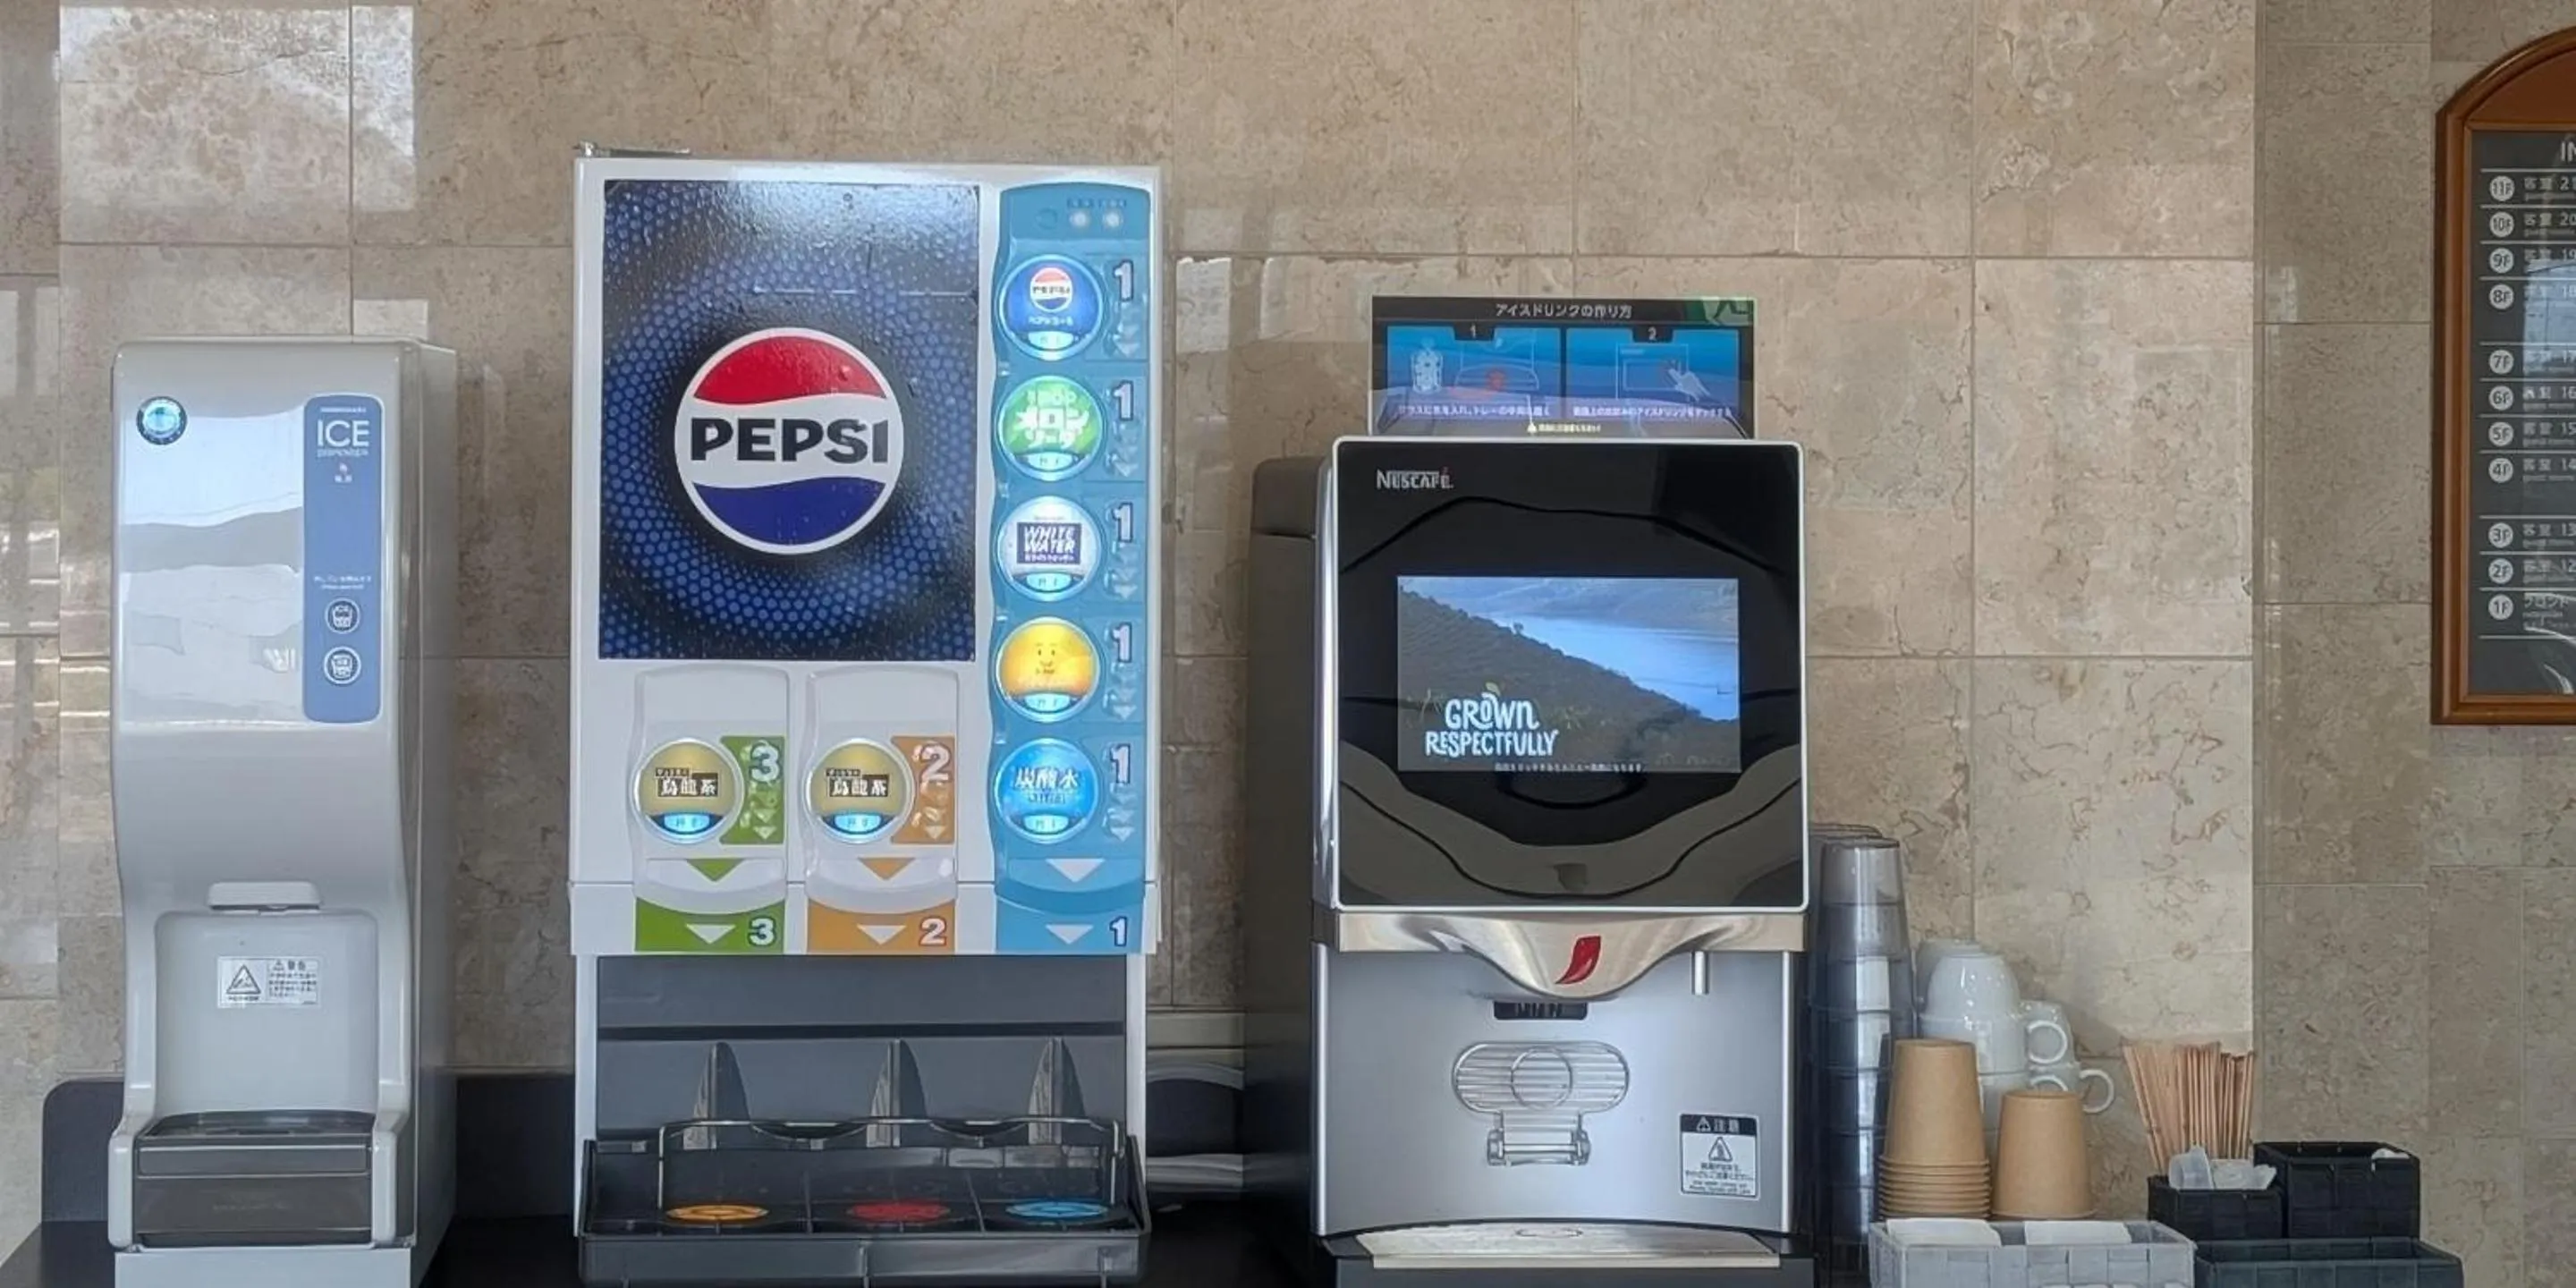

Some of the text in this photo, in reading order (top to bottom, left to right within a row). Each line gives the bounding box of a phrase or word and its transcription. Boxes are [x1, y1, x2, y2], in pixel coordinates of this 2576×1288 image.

[2493, 182, 2512, 196] 11F
[2493, 217, 2512, 233] 10F
[2493, 254, 2512, 267] 9F
[1114, 259, 1134, 302] 1
[1032, 285, 1071, 294] PEPSI
[2493, 290, 2511, 304] 8F
[1496, 302, 1633, 320] アイスドリンクの作り方
[1470, 325, 1478, 339] 1
[1648, 326, 1657, 341] 2
[2493, 355, 2511, 369] 7F
[1114, 379, 1134, 421] 1
[2493, 391, 2511, 404] 6F
[317, 419, 369, 447] ICE
[691, 418, 889, 464] PEPSI
[2492, 428, 2511, 441] 5F
[2492, 463, 2511, 477] 4F
[1113, 501, 1134, 543] 1
[1024, 525, 1076, 540] WHITE
[2492, 529, 2510, 542] 3F
[1024, 538, 1076, 554] WATER
[2492, 564, 2510, 578] 2F
[2492, 600, 2510, 614] 1F
[1111, 622, 1132, 663] 1
[1425, 728, 1560, 758] RESPECTFULLY
[748, 741, 781, 784] 3
[919, 741, 952, 784] 2
[1110, 743, 1132, 785] 1
[1014, 766, 1080, 789] 炭酸水
[748, 916, 777, 947] 3
[918, 916, 948, 947] 2
[1109, 914, 1130, 947] 1
